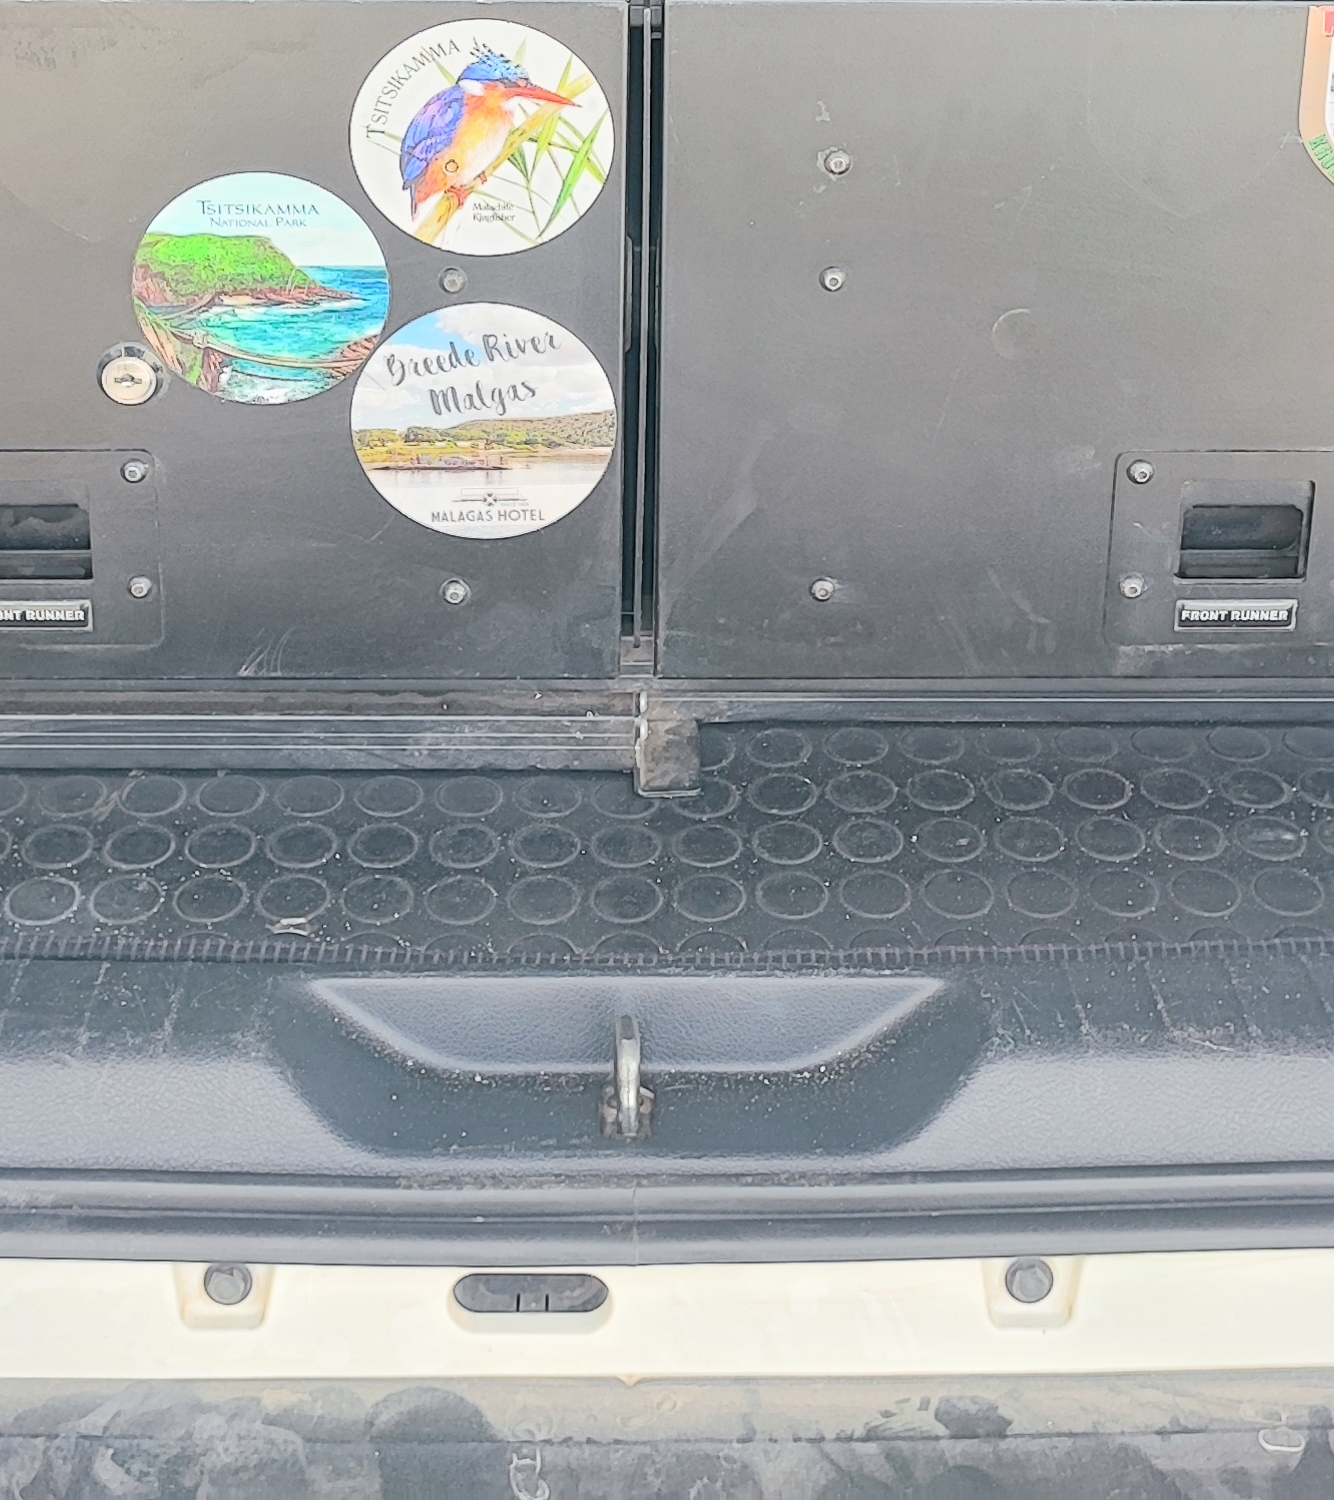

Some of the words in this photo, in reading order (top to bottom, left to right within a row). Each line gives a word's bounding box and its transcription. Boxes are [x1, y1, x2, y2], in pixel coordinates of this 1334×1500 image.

[365, 38, 461, 139] TSITSIKAMMA
[384, 341, 480, 387] Breede
[481, 331, 562, 363] River
[428, 380, 538, 416] Malgas
[431, 510, 493, 523] MALAGAS
[498, 509, 546, 521] HOTEL
[25, 609, 85, 621] RUNNER
[1181, 610, 1229, 621] FRONT
[1230, 610, 1289, 621] RUNNER
